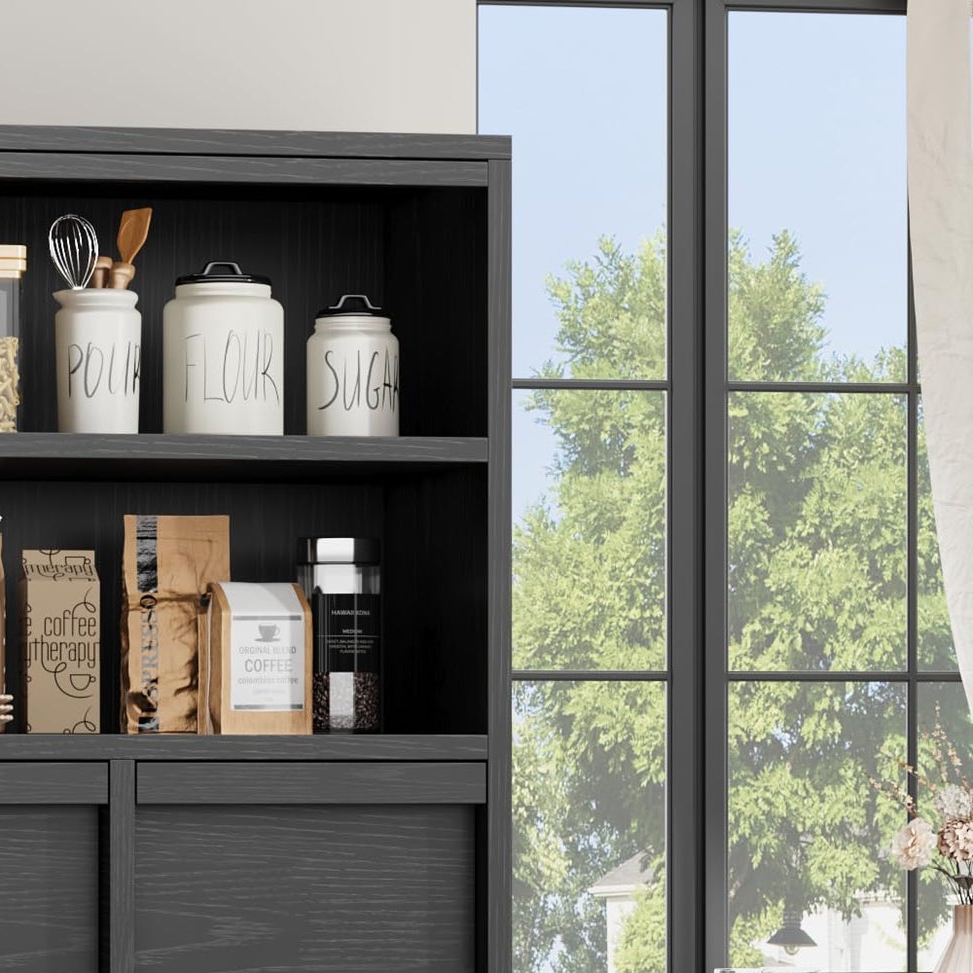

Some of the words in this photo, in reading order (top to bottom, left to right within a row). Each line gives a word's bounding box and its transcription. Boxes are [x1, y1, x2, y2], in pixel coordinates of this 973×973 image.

[184, 329, 280, 403] FLOUR
[43, 606, 97, 637] coffee
[33, 636, 97, 669] therapy
[244, 658, 293, 673] COFFEE
